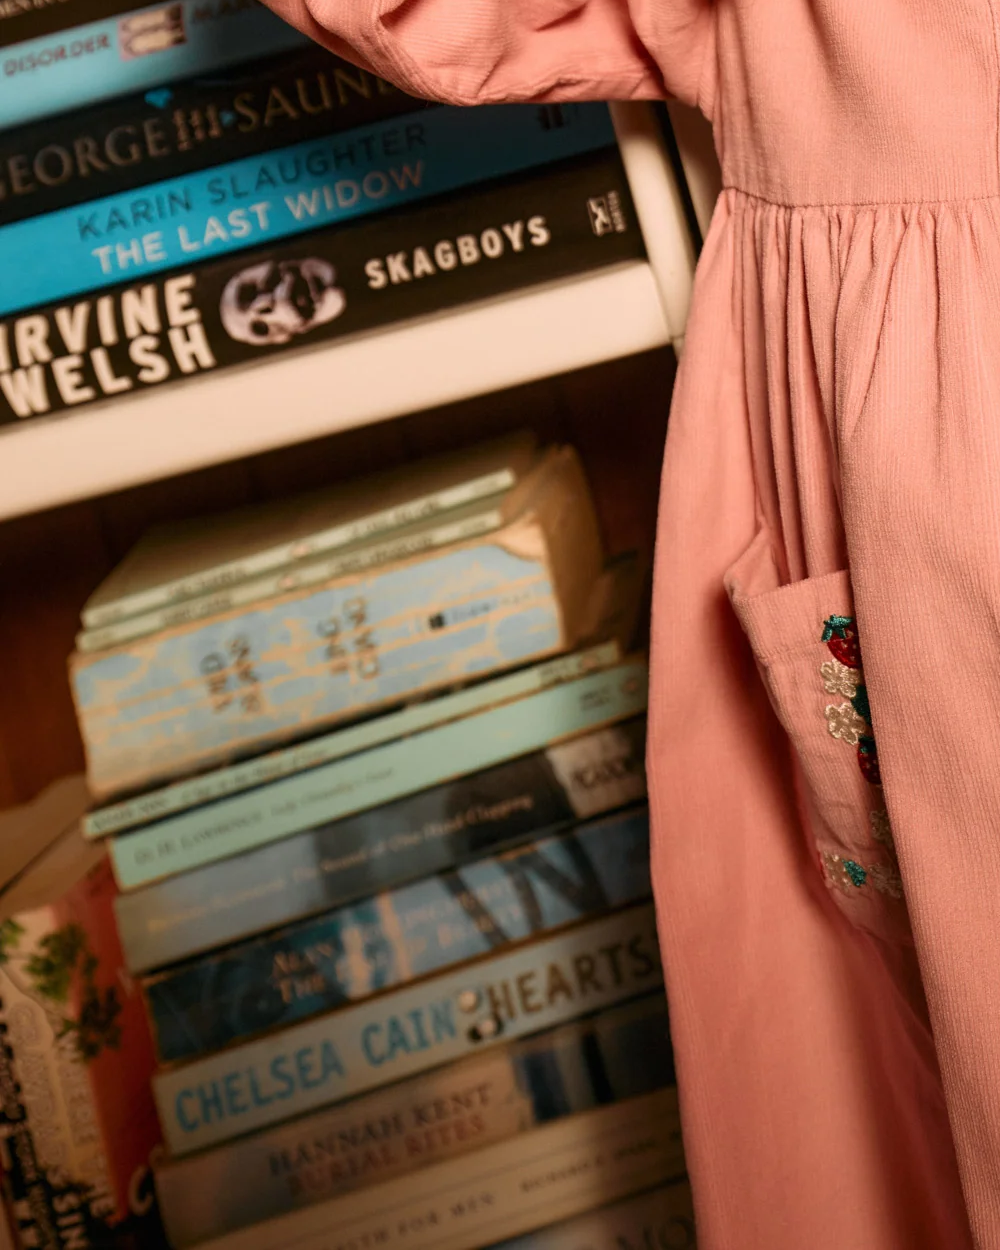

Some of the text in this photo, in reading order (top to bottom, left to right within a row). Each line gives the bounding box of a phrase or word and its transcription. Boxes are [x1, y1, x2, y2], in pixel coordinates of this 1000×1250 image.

[233, 64, 388, 134] SAUN
[77, 121, 429, 243] KARIN SLAUGHTER
[91, 158, 428, 275] THE LAST WIDOW
[363, 214, 552, 291] SKAGBOYS
[0, 318, 217, 419] WELSH
[174, 936, 660, 1135] CHELSEA CAIN HEARTS
[409, 1080, 497, 1129] KENT
